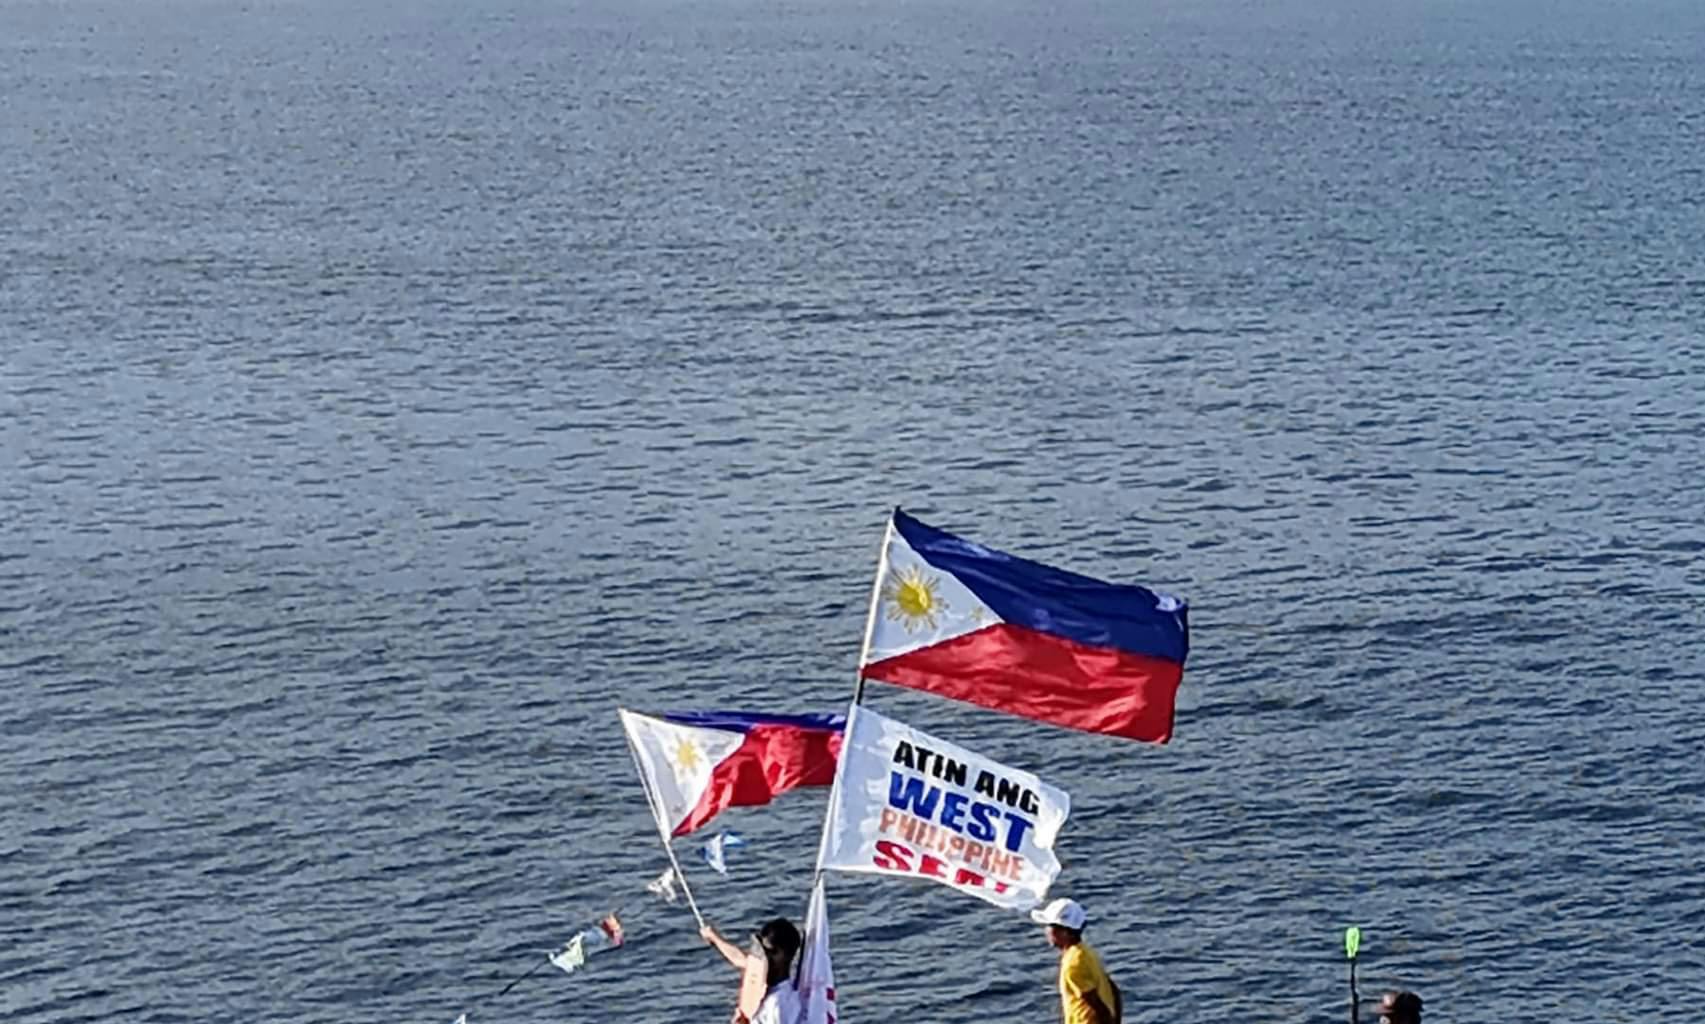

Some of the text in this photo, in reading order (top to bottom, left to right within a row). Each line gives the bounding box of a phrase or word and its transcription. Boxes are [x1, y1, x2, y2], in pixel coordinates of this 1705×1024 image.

[889, 771, 1034, 853] WEST
[893, 740, 1041, 815] ATIN ANG
